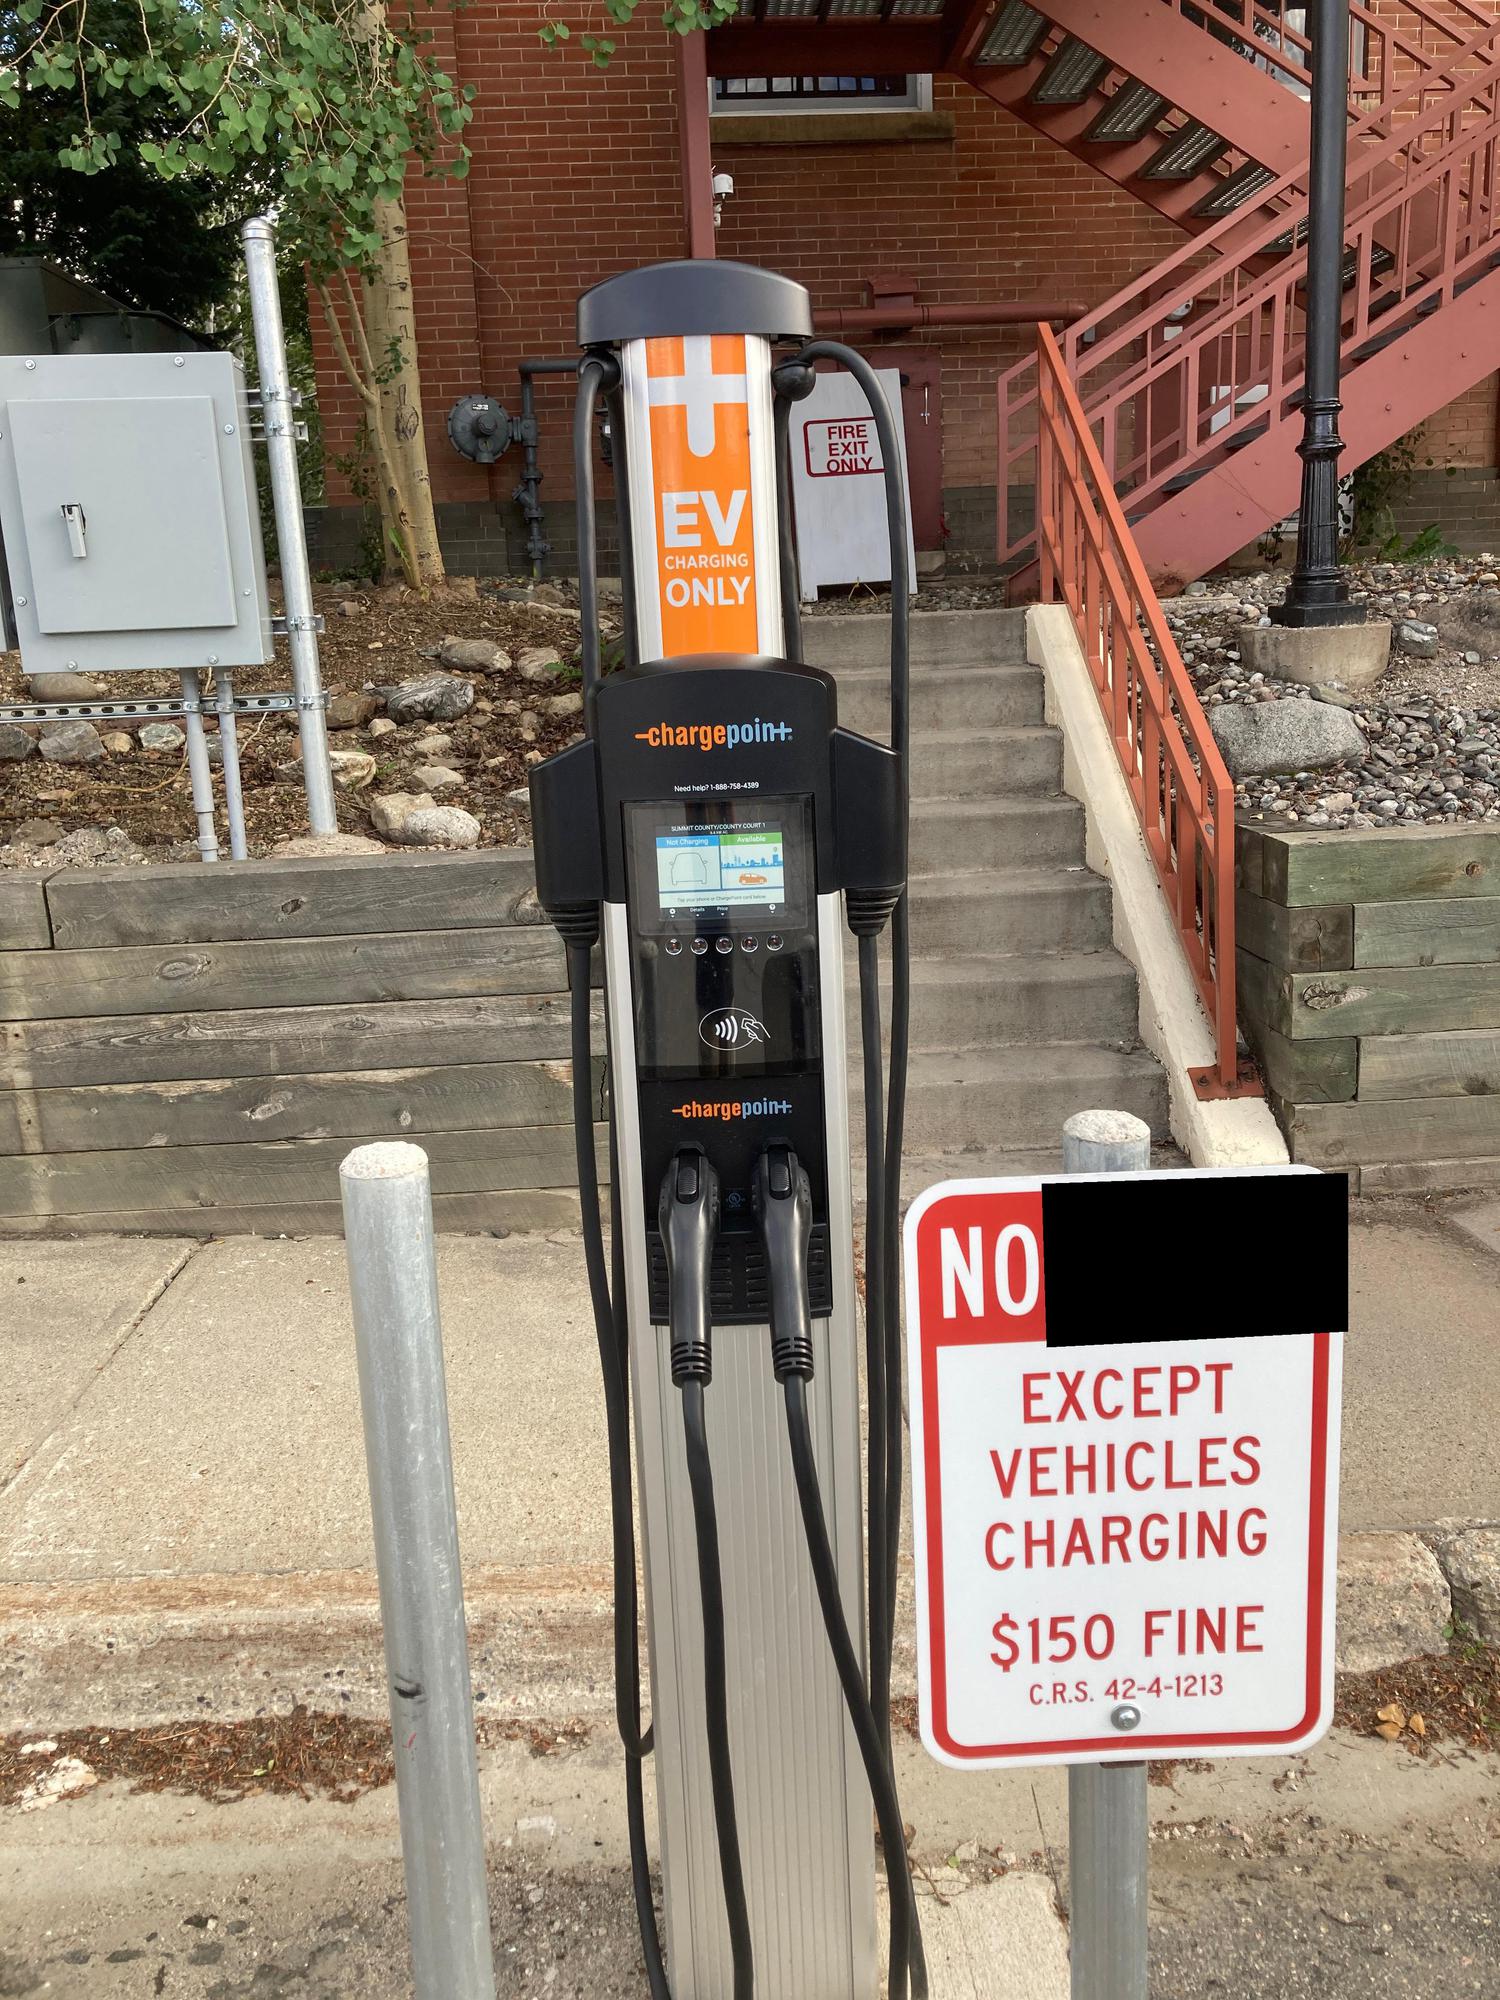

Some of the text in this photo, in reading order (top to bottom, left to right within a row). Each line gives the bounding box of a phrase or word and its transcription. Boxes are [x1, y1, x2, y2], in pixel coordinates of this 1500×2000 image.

[827, 424, 867, 440] FIRE
[828, 440, 869, 457] EXIT
[826, 456, 873, 473] ONLY
[661, 489, 748, 548] EV
[664, 553, 749, 570] CHARGING
[665, 575, 751, 608] ONLY
[692, 784, 709, 793] help?
[710, 781, 760, 791] 1-888-758-4389
[694, 823, 742, 831] COUNTY/COUNTY
[736, 835, 767, 843] Available
[679, 838, 709, 847] Charging
[939, 1223, 1040, 1319] NO
[1021, 1362, 1233, 1425] EXCEPT
[989, 1434, 1262, 1499] VEHICLES
[984, 1507, 1268, 1571] CHARGING
[989, 1605, 1265, 1672] $150 FINE
[1028, 1673, 1224, 1706] C.R.S. 42-4-1213
